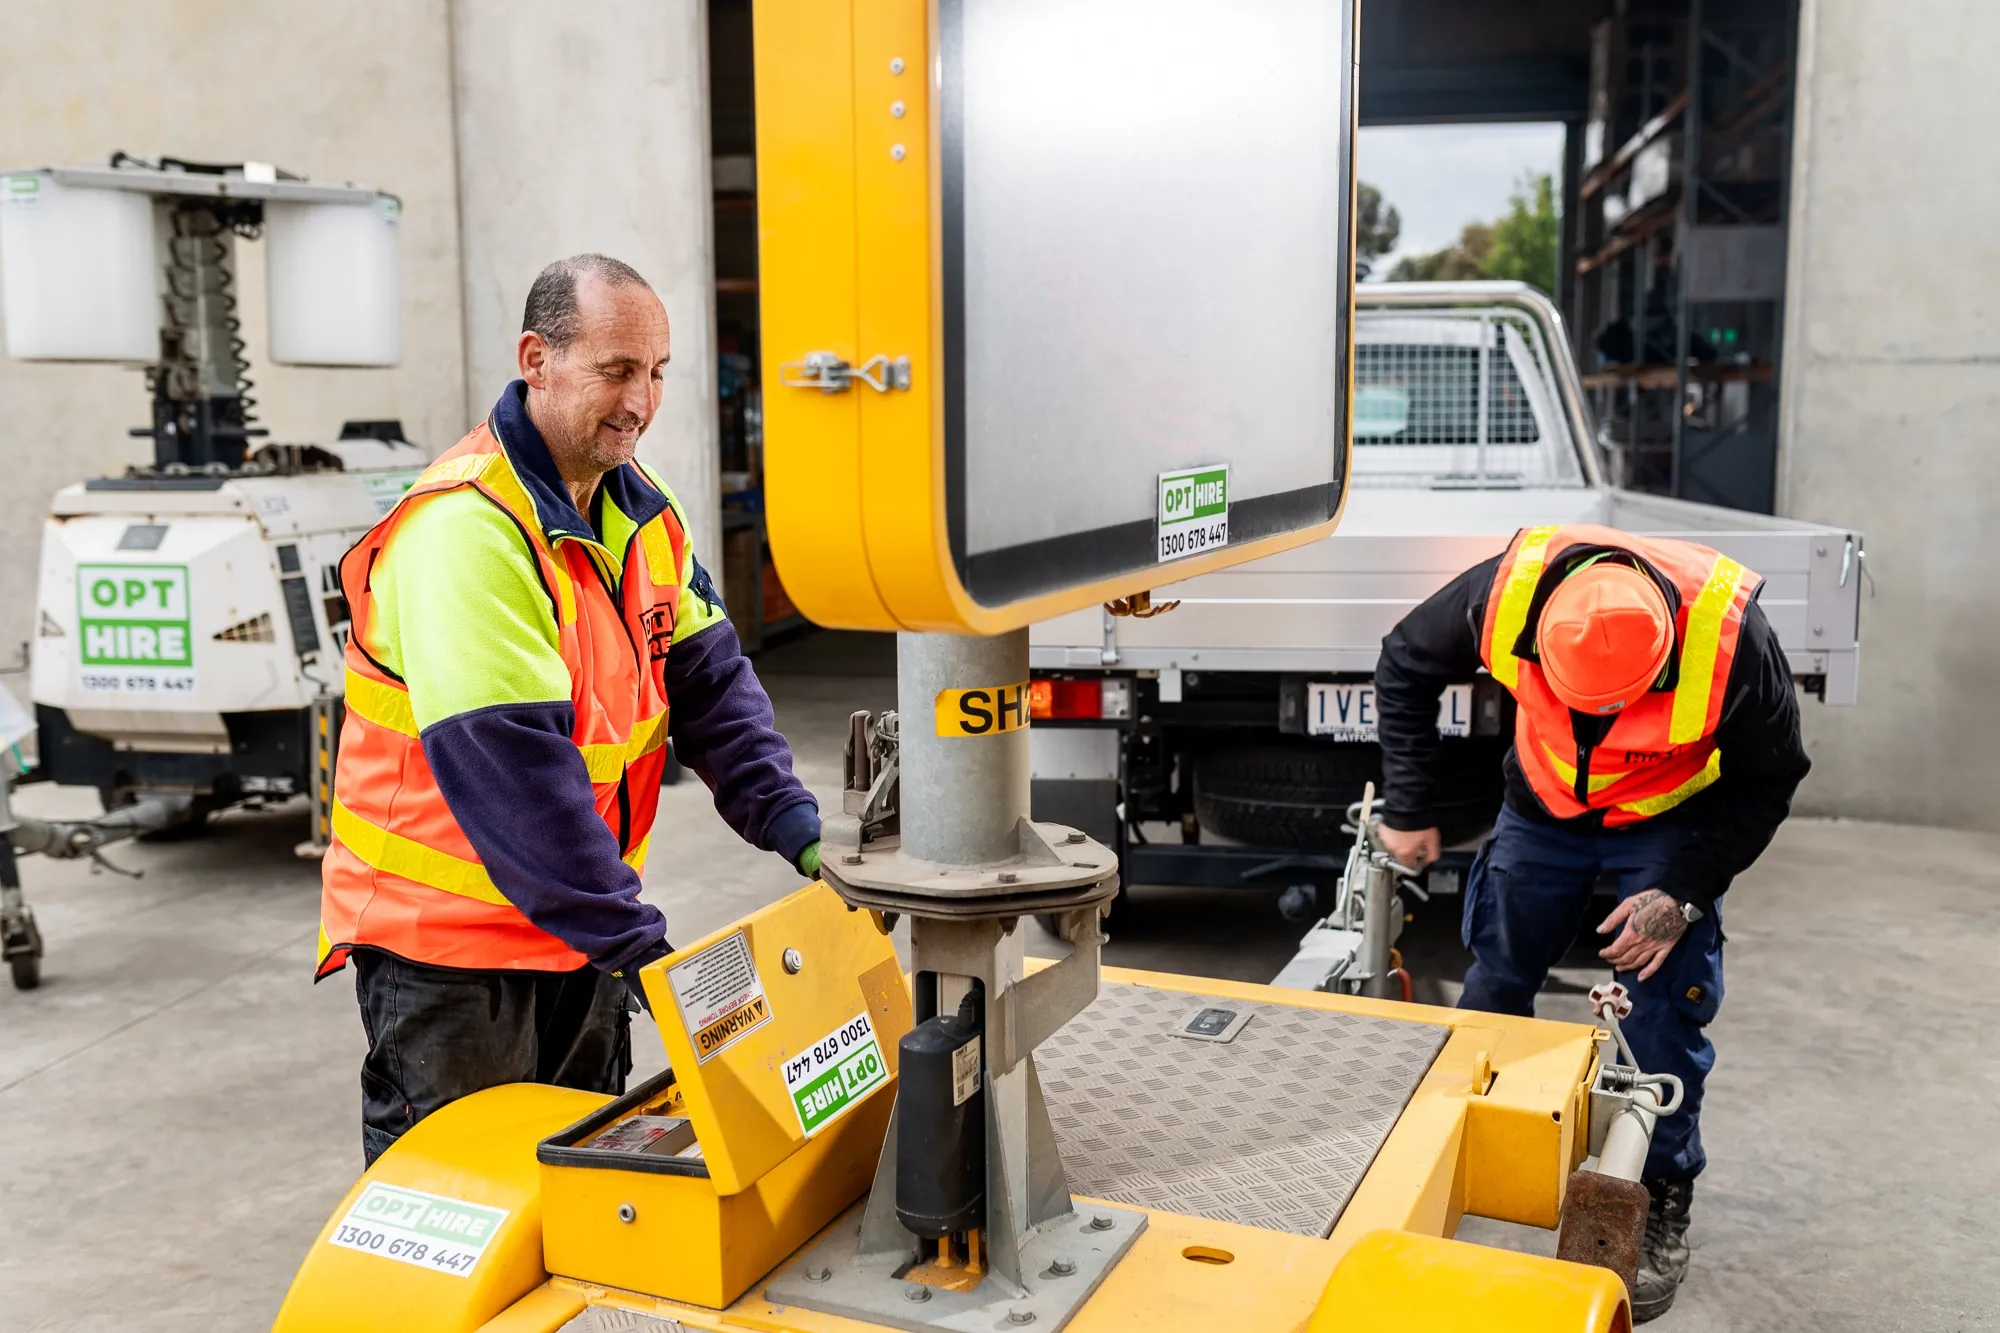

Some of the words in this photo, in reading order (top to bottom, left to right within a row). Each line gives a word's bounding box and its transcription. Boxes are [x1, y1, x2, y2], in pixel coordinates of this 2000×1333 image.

[1165, 486, 1191, 513] OPT
[1195, 480, 1224, 508] HIRE
[1161, 532, 1185, 556] 1300
[1188, 527, 1206, 550] 678
[1208, 522, 1226, 544] 447
[91, 578, 175, 608] OPT
[85, 624, 186, 660] HIRE
[82, 675, 120, 690] 1300
[126, 676, 156, 691] 678
[163, 676, 195, 691] 447
[717, 999, 737, 1015] BEFORE
[737, 990, 754, 1005] CHECK
[698, 1008, 717, 1027] TOWING
[700, 1006, 756, 1050] WARNING
[840, 1016, 871, 1047] 1300
[813, 1037, 838, 1064] 678
[787, 1056, 810, 1085] 447
[846, 1053, 878, 1090] OPT
[801, 1075, 844, 1120] HIRE
[365, 1195, 423, 1224] OPT
[421, 1207, 491, 1238] HIRE
[337, 1225, 385, 1250] 1300
[388, 1238, 429, 1261] 678
[432, 1250, 476, 1272] 447
